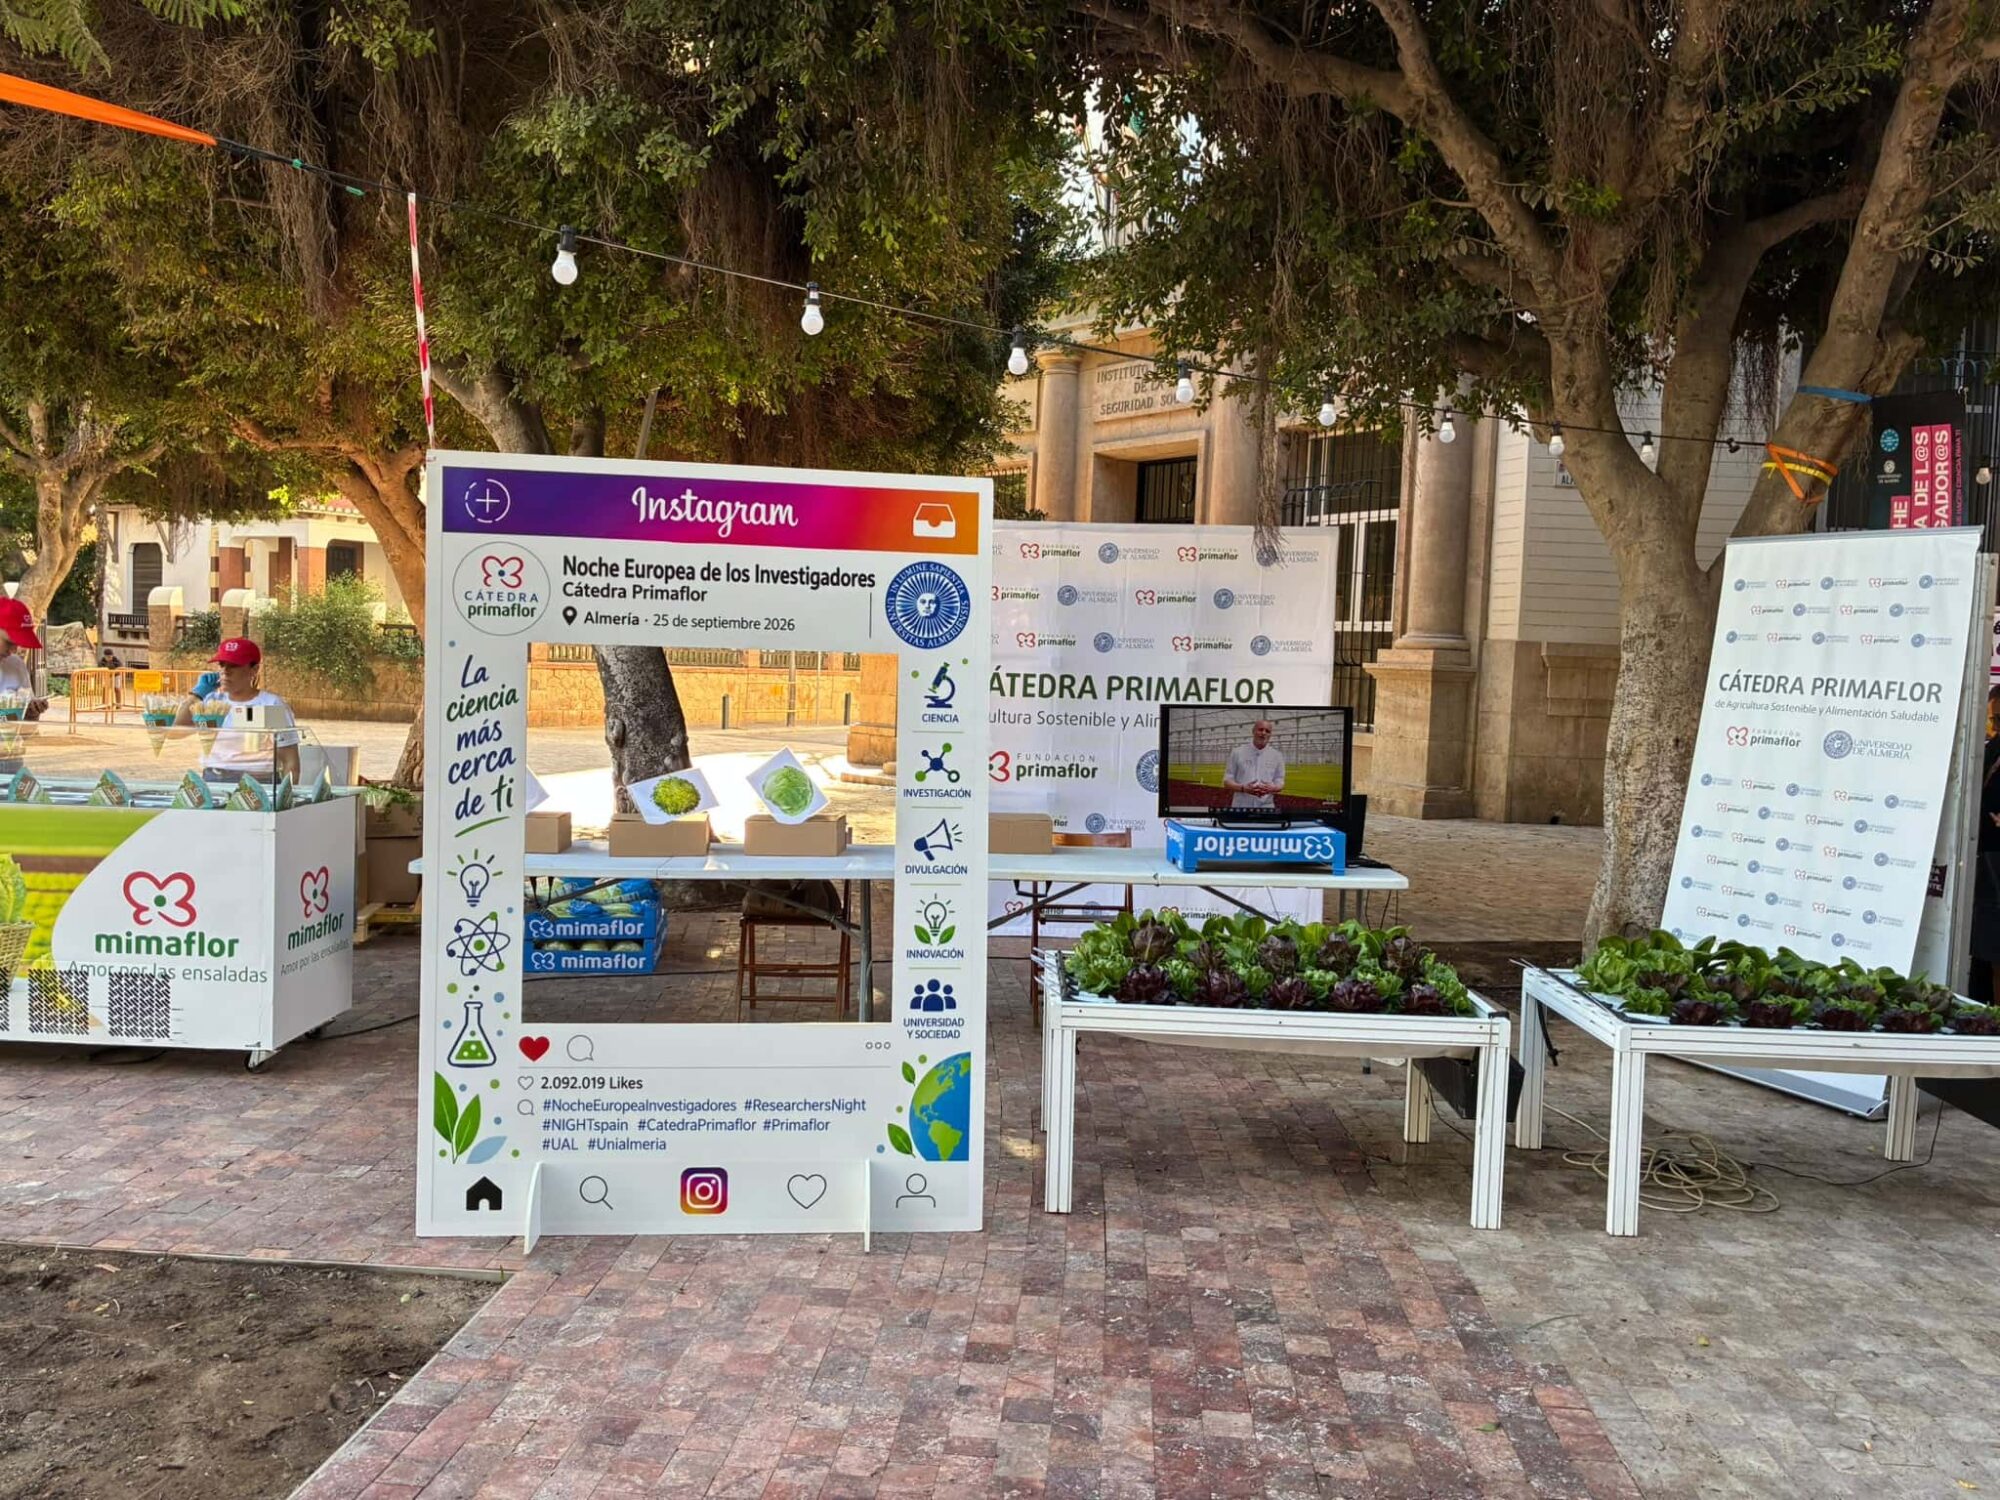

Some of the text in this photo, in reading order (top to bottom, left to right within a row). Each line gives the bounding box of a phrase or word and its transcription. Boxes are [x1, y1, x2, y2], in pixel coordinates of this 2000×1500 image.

[1133, 380, 1164, 394] DE LA
[1100, 397, 1154, 416] SEGURIDAD
[1914, 431, 1929, 475] L@S
[1914, 480, 1929, 507] DE
[631, 486, 799, 538] Instagram
[563, 555, 876, 590] Noche Europea de los Investigadores
[464, 588, 539, 603] CÁTEDRA
[562, 581, 708, 601] Cátedra Primaflor
[467, 602, 537, 619] primaflor
[584, 611, 795, 632] Almería 25 de septiembre 2026
[461, 654, 490, 688] La
[1106, 675, 1274, 704] PRIMAFLOR
[1718, 669, 1943, 704] CÁTEDRA PRIMAFLOR
[446, 684, 520, 722] ciencia
[1714, 699, 1939, 723] de Agricultura Sostenible y Alimentación Saludable
[921, 713, 959, 723] CIENCIA
[1036, 710, 1116, 727] Sostenible
[1120, 716, 1130, 731] y
[456, 719, 503, 752] más
[1750, 734, 1802, 748] primaflor
[448, 746, 516, 784] cerca
[1016, 763, 1099, 781] primaflor
[455, 774, 514, 820] de ti
[903, 787, 972, 799] INVESTIGACIÓN
[1193, 834, 1301, 857] mimaflor
[905, 864, 968, 875] DIVULGACIÓN
[288, 912, 345, 951] mimaflor
[556, 919, 644, 936] mimaflor
[95, 931, 239, 958] mimaflor
[906, 947, 964, 959] INNOVACIÓN
[68, 960, 113, 977] Amor
[182, 965, 268, 983] ensaladas
[561, 954, 647, 969] mimaflor
[903, 1018, 965, 1027] UNIVERSIDAD
[907, 1030, 961, 1039] Y SOCIEDAD
[541, 1076, 643, 1090] 2.092.019 Likes
[543, 1098, 867, 1114] #NocheEuropeaInvestigadores #ResearchersNight
[542, 1118, 830, 1134] #NIGHTspain #CatedraPrimaflor #Primaflor
[542, 1137, 667, 1151] #UAL #Unialmeria
